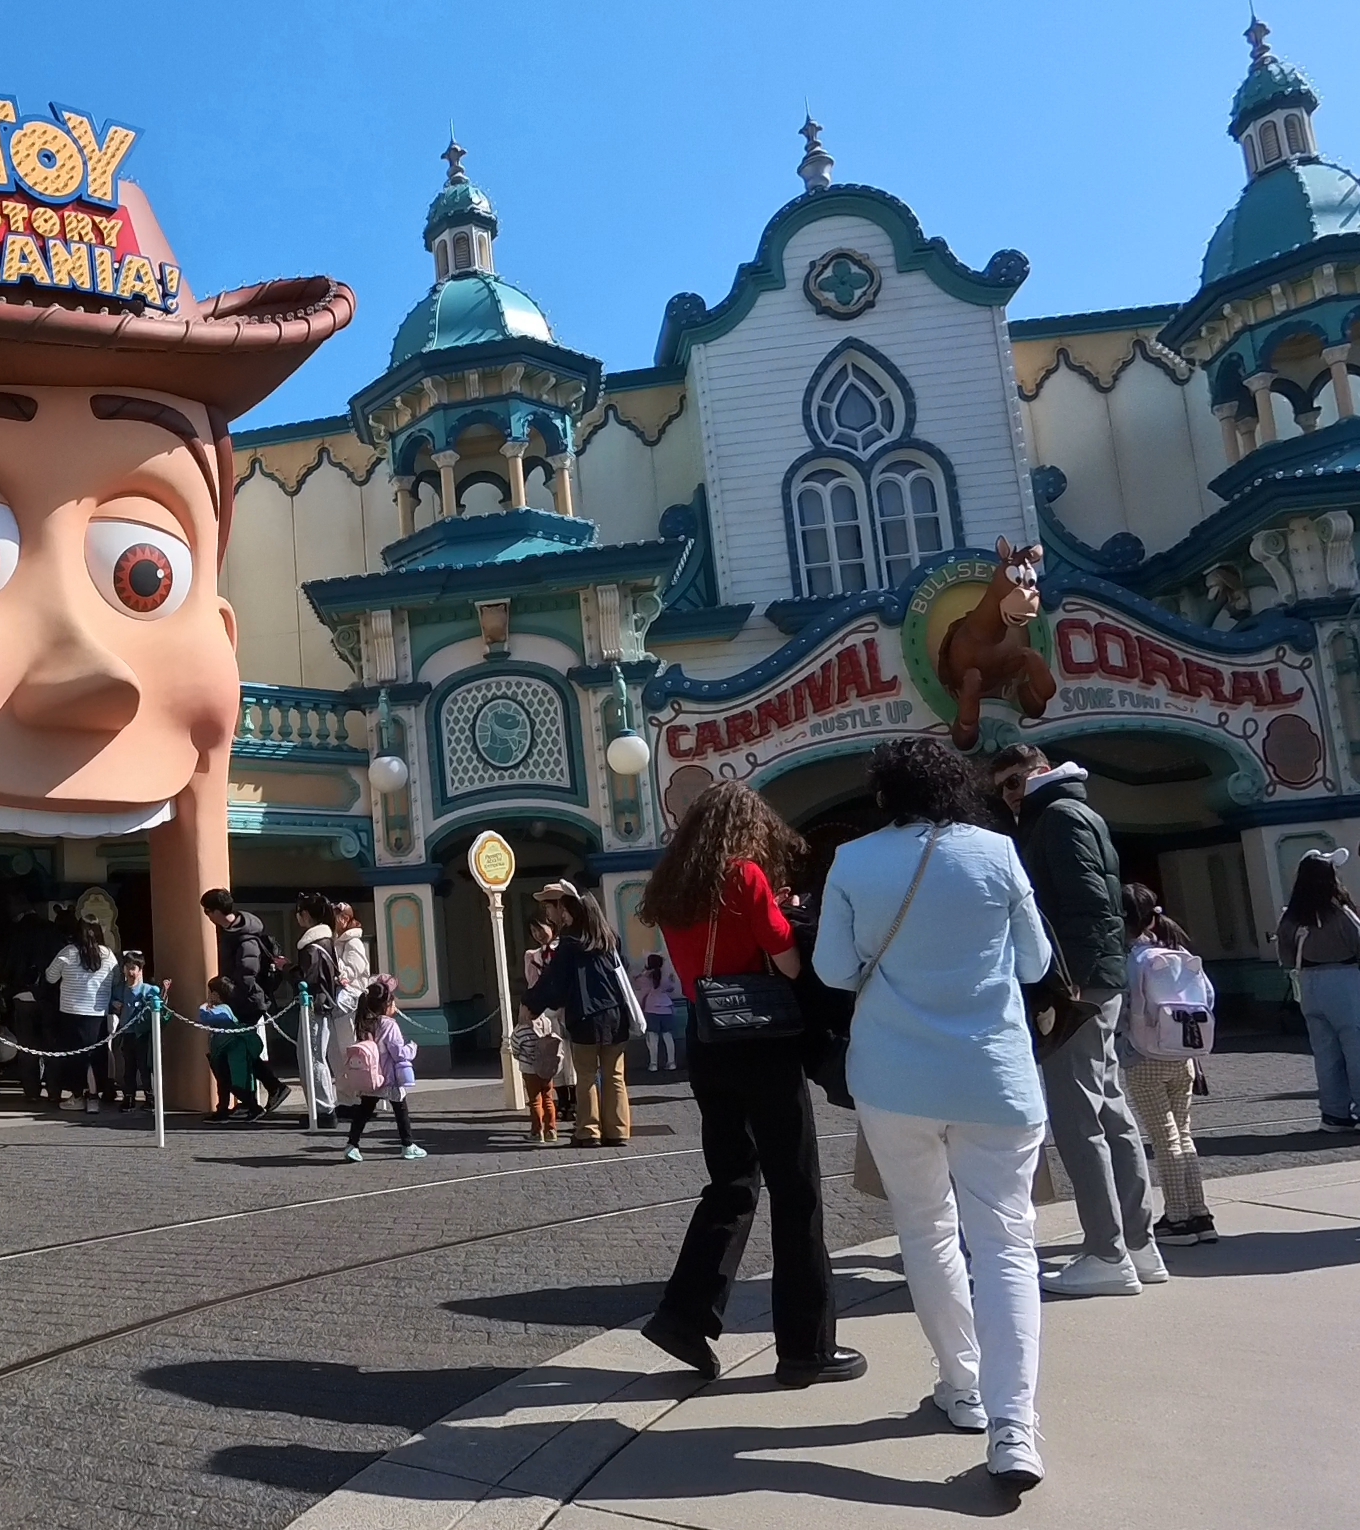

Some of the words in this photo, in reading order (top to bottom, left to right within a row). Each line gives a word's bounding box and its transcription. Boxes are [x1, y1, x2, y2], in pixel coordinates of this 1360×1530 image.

[666, 637, 899, 760] CARNIVAL
[1056, 618, 1305, 711] CORRAL
[1060, 686, 1115, 712] SOME
[809, 704, 882, 737] RUSTLE
[885, 700, 913, 725] UP
